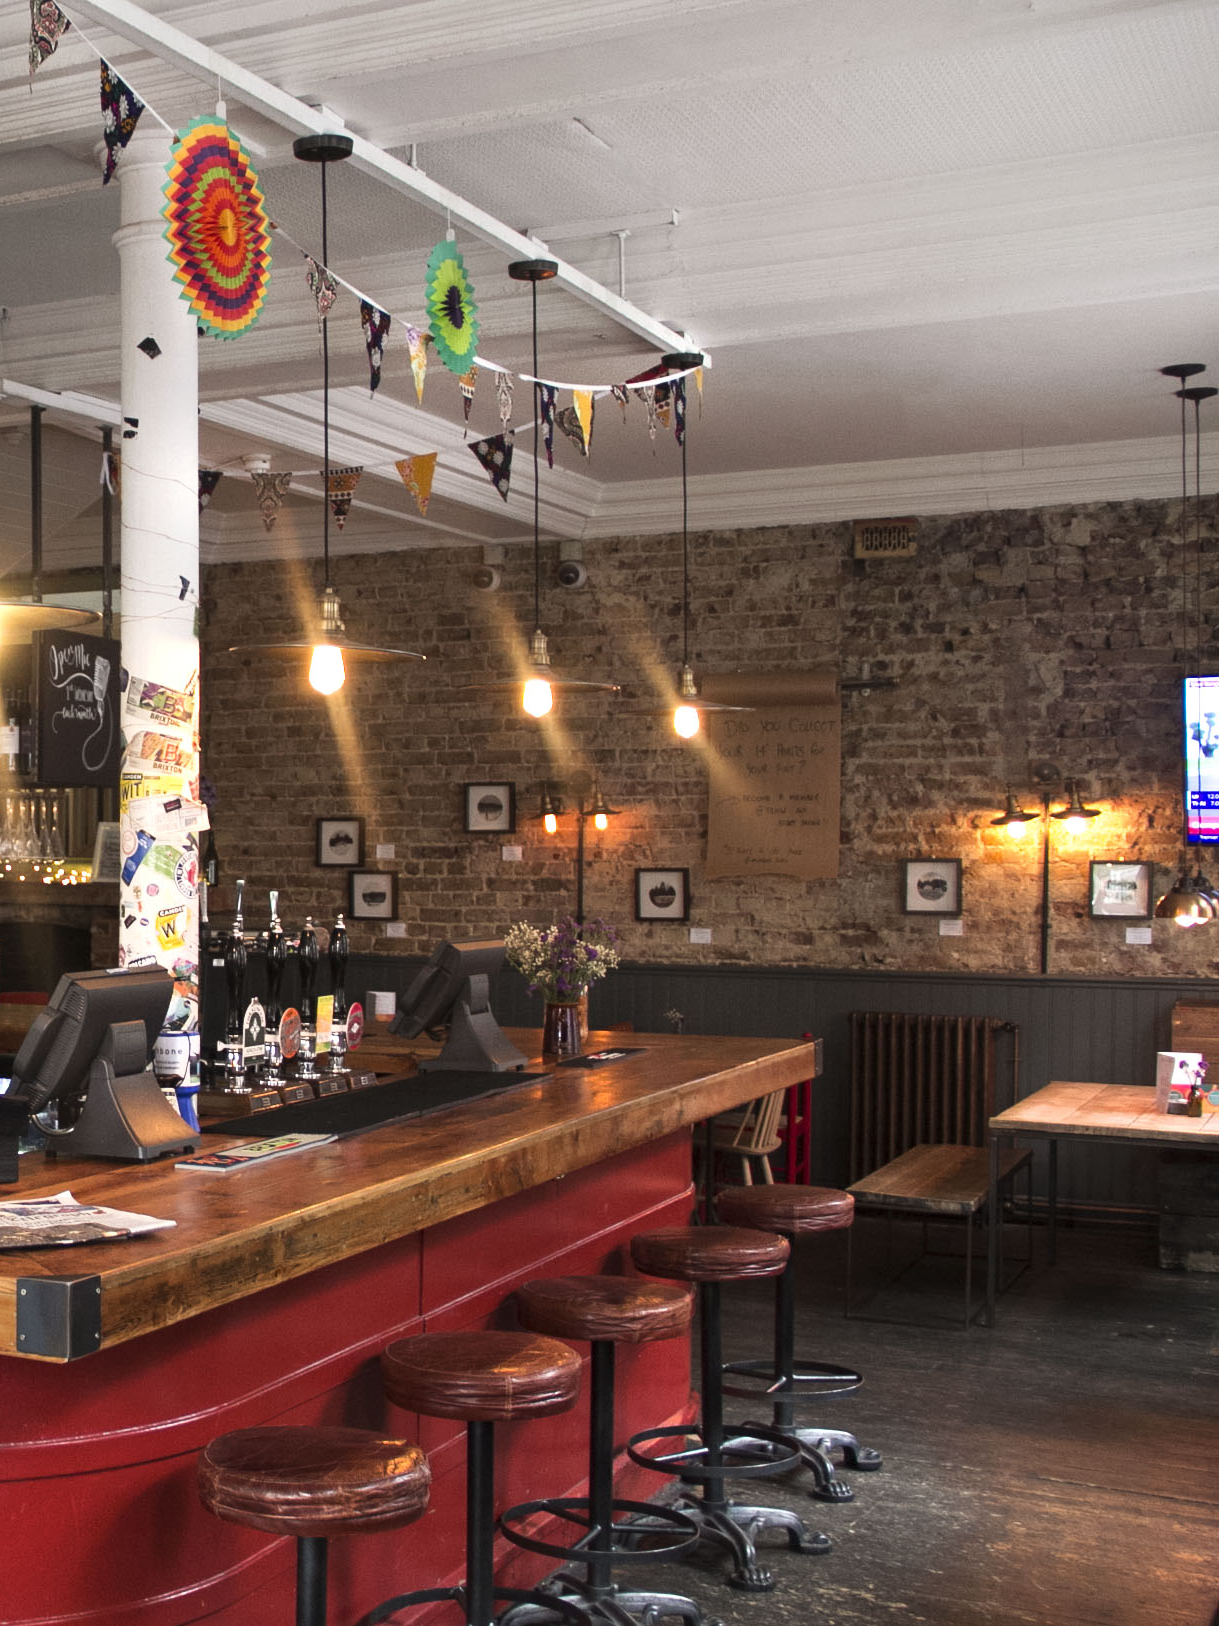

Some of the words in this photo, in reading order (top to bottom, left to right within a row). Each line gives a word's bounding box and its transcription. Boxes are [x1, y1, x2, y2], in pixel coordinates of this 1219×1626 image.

[153, 762, 183, 774] BRIXTON
[121, 781, 142, 800] WIT
[159, 905, 185, 917] CAMDE
